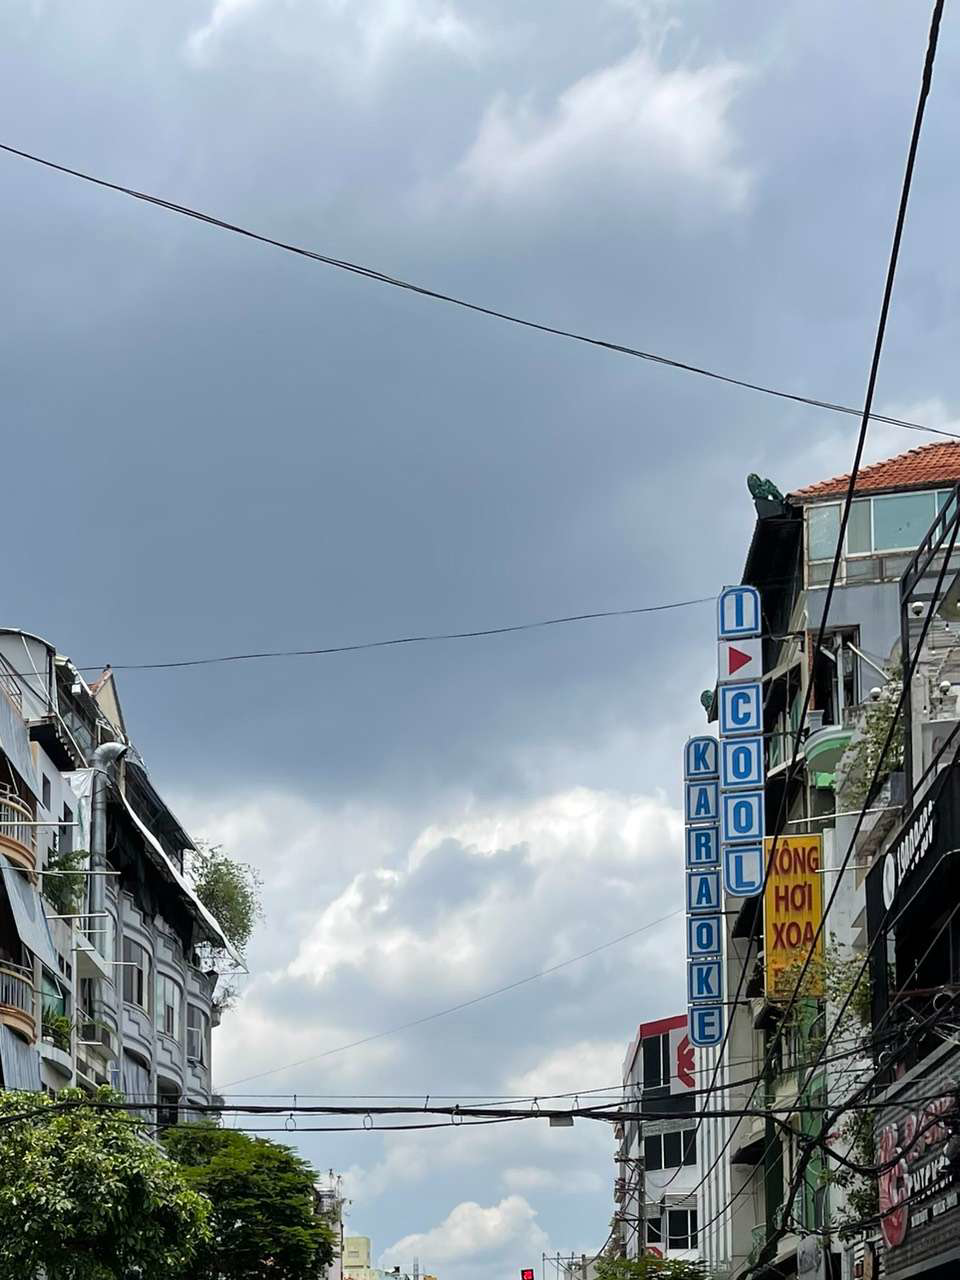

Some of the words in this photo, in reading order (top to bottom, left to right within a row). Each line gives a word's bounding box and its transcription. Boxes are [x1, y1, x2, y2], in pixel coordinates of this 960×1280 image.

[691, 741, 718, 1041] KARAOKE
[774, 881, 813, 913] HƠI
[772, 921, 816, 950] XOA
